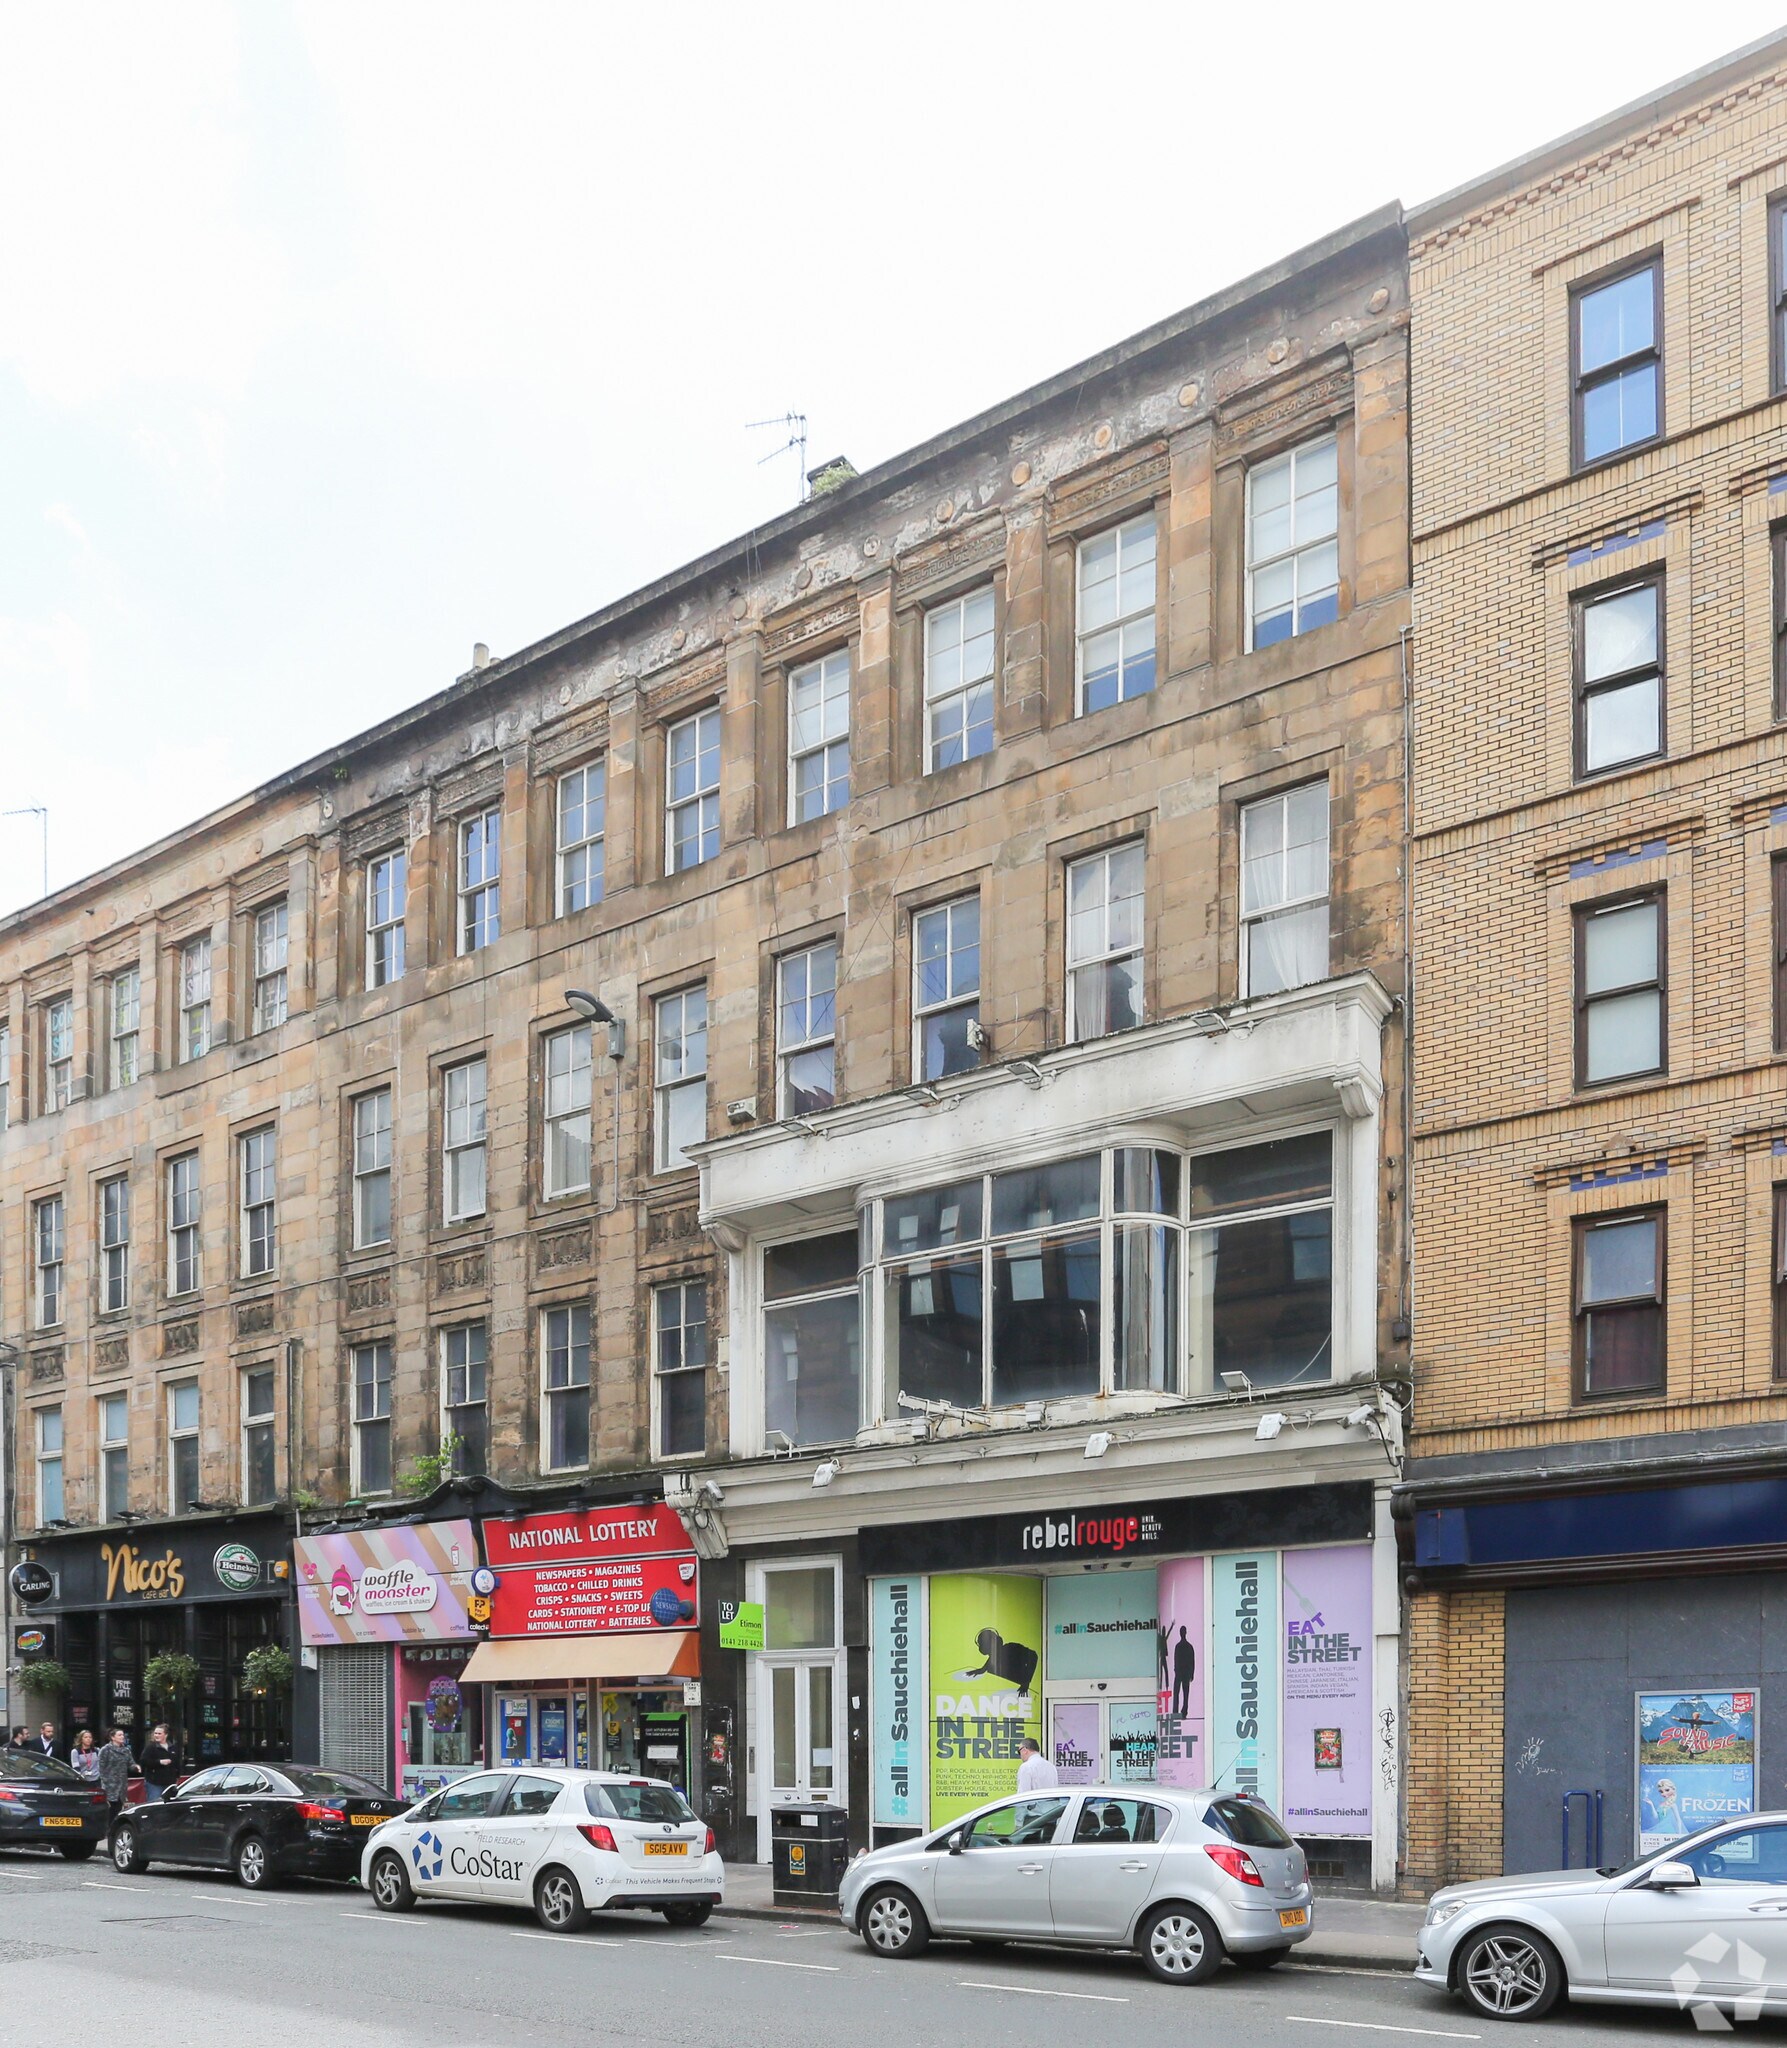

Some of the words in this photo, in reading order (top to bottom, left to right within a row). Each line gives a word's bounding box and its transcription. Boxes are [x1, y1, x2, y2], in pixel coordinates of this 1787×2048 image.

[509, 1526, 583, 1549] NATIONAL
[590, 1519, 658, 1542] LOTTERY
[101, 1543, 184, 1600] Nico's
[221, 1561, 258, 1574] Heineken
[536, 1568, 587, 1581] NEWSPAPERS
[594, 1564, 642, 1576] MAGAZINES
[20, 1581, 50, 1592] CARLING
[364, 1570, 414, 1588] waffle
[534, 1583, 568, 1593] TOBACCO
[577, 1580, 609, 1590] CHILLED
[612, 1578, 643, 1588] DRINKS
[365, 1585, 430, 1600] monster
[536, 1595, 563, 1606] CRISPS
[571, 1593, 602, 1604] SNACKS
[611, 1590, 643, 1601] SWEETS
[528, 1609, 553, 1619] CARDS
[560, 1605, 607, 1617] STATIONERY
[616, 1603, 640, 1614] E-TOP
[722, 1602, 734, 1611] TO
[527, 1620, 563, 1631] NATIONAL
[564, 1619, 597, 1630] LOTTERY
[608, 1616, 652, 1627] BATTERIES
[722, 1611, 734, 1620] LET
[1055, 1618, 1158, 1634] #allinSauchiehall
[1288, 1612, 1325, 1636] EAT
[1288, 1635, 1307, 1650] IN
[1311, 1633, 1350, 1649] THE
[1287, 1647, 1362, 1664] STREET
[890, 1584, 909, 1817] #allinSauchiehall
[936, 1695, 1033, 1718] DANCE
[1157, 1691, 1172, 1714] ET
[937, 1716, 964, 1738] IN
[971, 1717, 1025, 1738] THE
[1157, 1713, 1182, 1736] HE
[1056, 1739, 1075, 1751] EAT
[1657, 1727, 1709, 1747] SOUND
[1686, 1733, 1737, 1752] MUSIC
[936, 1738, 1021, 1759] STREE
[1126, 1742, 1156, 1751] HEAR
[1157, 1736, 1198, 1759] EET
[1056, 1751, 1066, 1759] IN
[1068, 1751, 1088, 1759] THE
[1056, 1759, 1094, 1767] STREET
[1116, 1759, 1155, 1767] STREET
[1122, 1751, 1133, 1759] IN
[1135, 1751, 1155, 1759] THE
[1288, 1807, 1368, 1817] #allinSauchiehall
[1681, 1798, 1751, 1813] FROZEN
[477, 1835, 493, 1844] FIELD
[494, 1836, 526, 1846] RESEARCH
[649, 1845, 667, 1854] SG15
[668, 1844, 684, 1854] AVV
[451, 1847, 523, 1881] CoStar
[681, 1877, 704, 1885] Frequent
[704, 1877, 716, 1885] Stops
